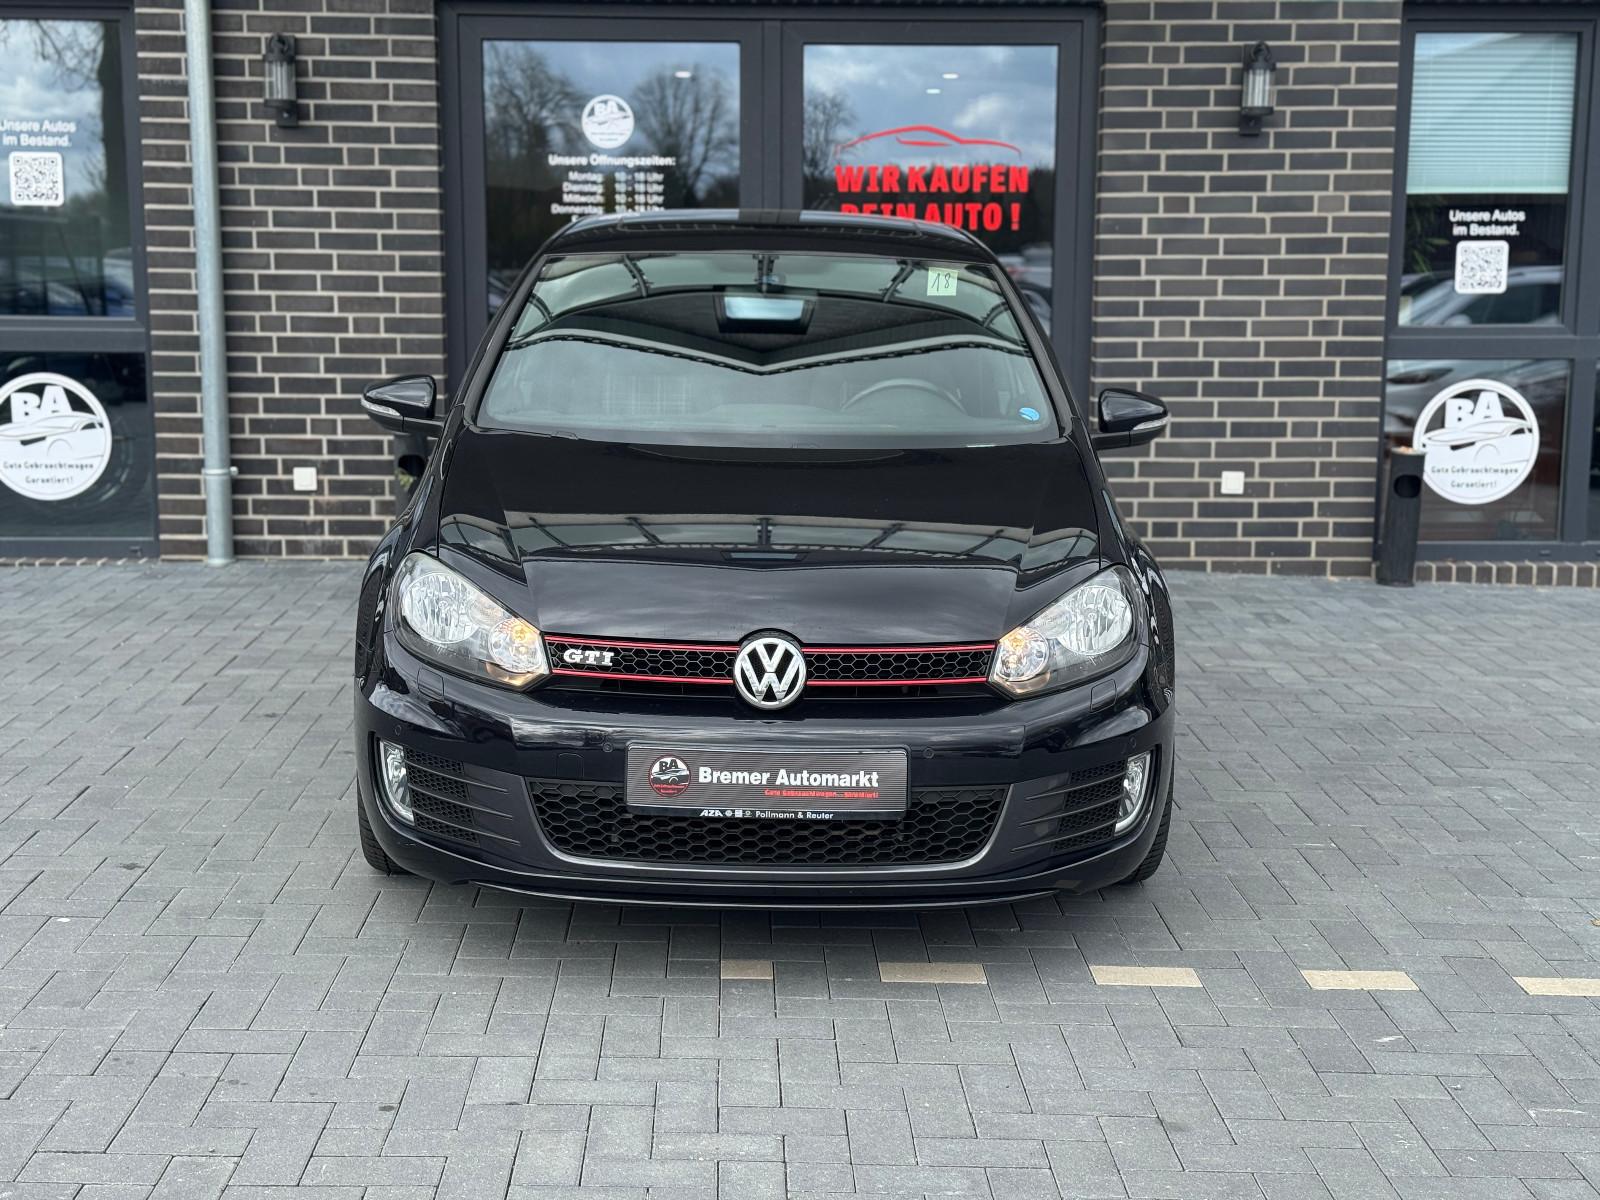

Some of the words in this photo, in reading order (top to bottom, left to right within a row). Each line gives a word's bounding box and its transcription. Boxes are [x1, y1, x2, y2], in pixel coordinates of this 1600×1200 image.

[593, 100, 618, 116] BA
[42, 120, 77, 133] Autos
[3, 133, 18, 146] im
[20, 133, 72, 147] Bestand.
[548, 153, 588, 166] Unsere
[834, 165, 900, 193] WIR
[907, 165, 1029, 193] KAUFEN
[924, 203, 1003, 231] AUTO
[1448, 209, 1491, 222] Unsere
[1492, 209, 1526, 222] Autos
[1452, 224, 1468, 236] im
[1469, 223, 1520, 236] Bestand.
[931, 272, 952, 293] 18
[10, 385, 73, 423] BA
[1444, 391, 1504, 428] BA
[563, 649, 615, 667] GTI
[658, 760, 679, 772] BA
[698, 766, 771, 785] Bremer
[775, 768, 879, 788] Automarkt
[700, 809, 723, 817] AZA
[755, 810, 795, 819] Pollmann
[797, 811, 804, 819] &
[806, 811, 834, 820] Reuter
